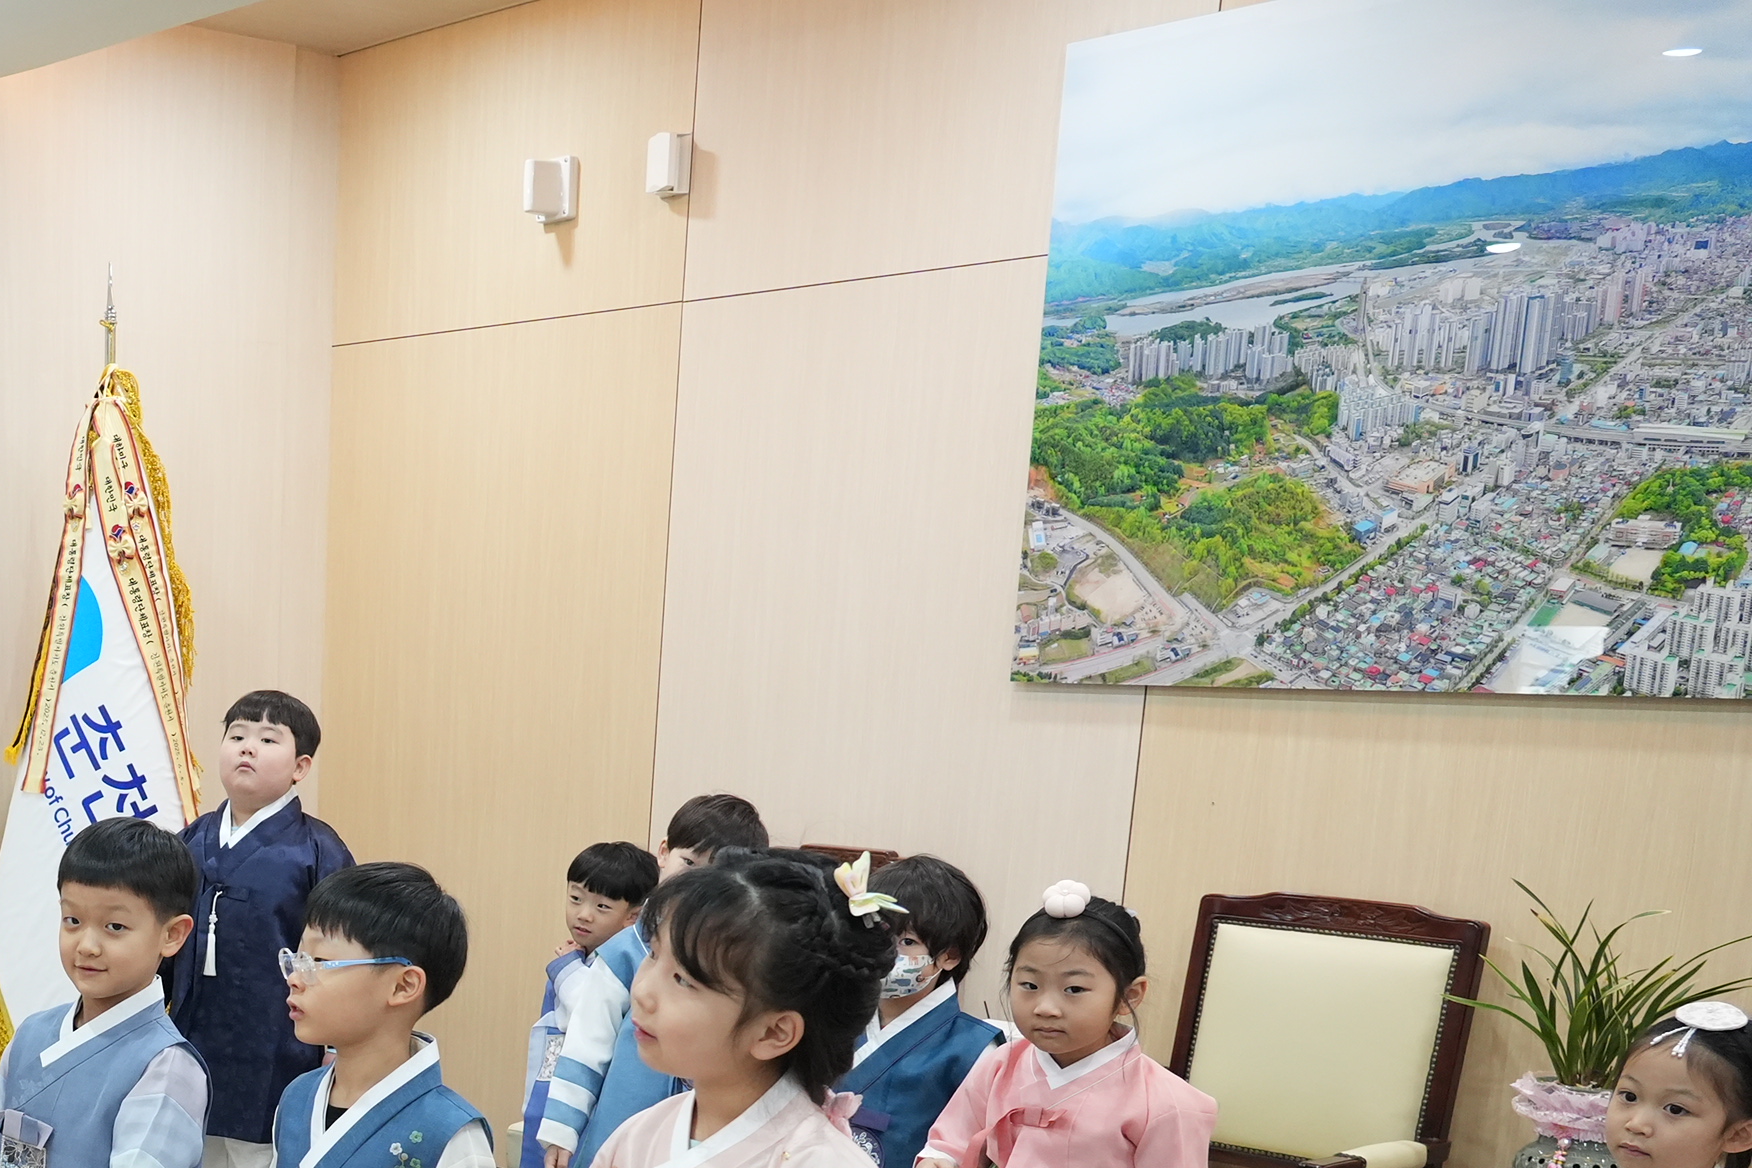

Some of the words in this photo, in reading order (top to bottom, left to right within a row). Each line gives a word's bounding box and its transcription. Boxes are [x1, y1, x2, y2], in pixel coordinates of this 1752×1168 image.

[104, 476, 119, 512] 대한민국
[54, 704, 158, 824] 춘천
[44, 786, 63, 806] of
[54, 807, 73, 846] Chu
